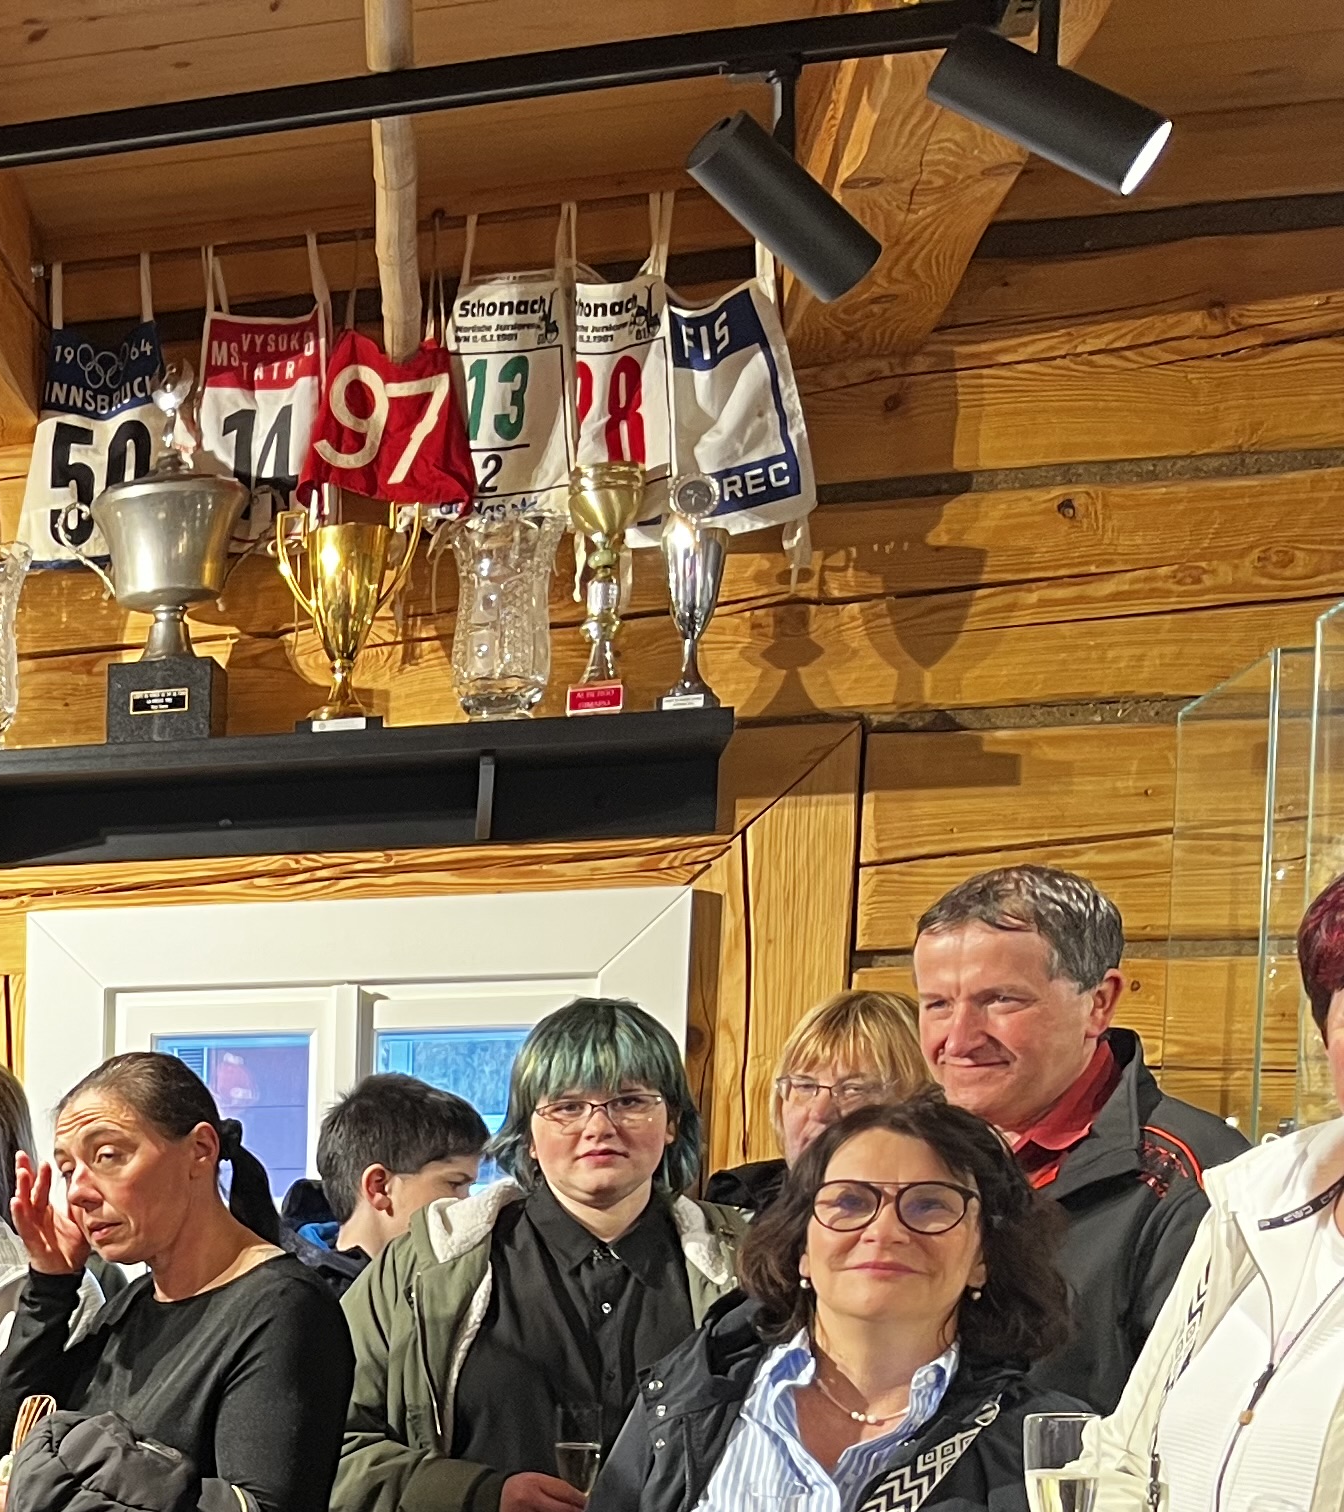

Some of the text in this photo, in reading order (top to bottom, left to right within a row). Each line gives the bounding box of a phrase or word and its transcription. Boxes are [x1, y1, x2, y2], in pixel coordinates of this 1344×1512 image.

[458, 295, 547, 318] Schonach
[54, 338, 154, 364] 19 64
[212, 340, 239, 368] MS
[680, 311, 731, 361] FIS
[241, 361, 300, 381] TATR
[468, 355, 530, 442] 13
[313, 363, 450, 486] 97
[222, 403, 299, 520] 14
[478, 453, 504, 494] 2
[723, 462, 790, 501] REC
[49, 418, 152, 547] 50
